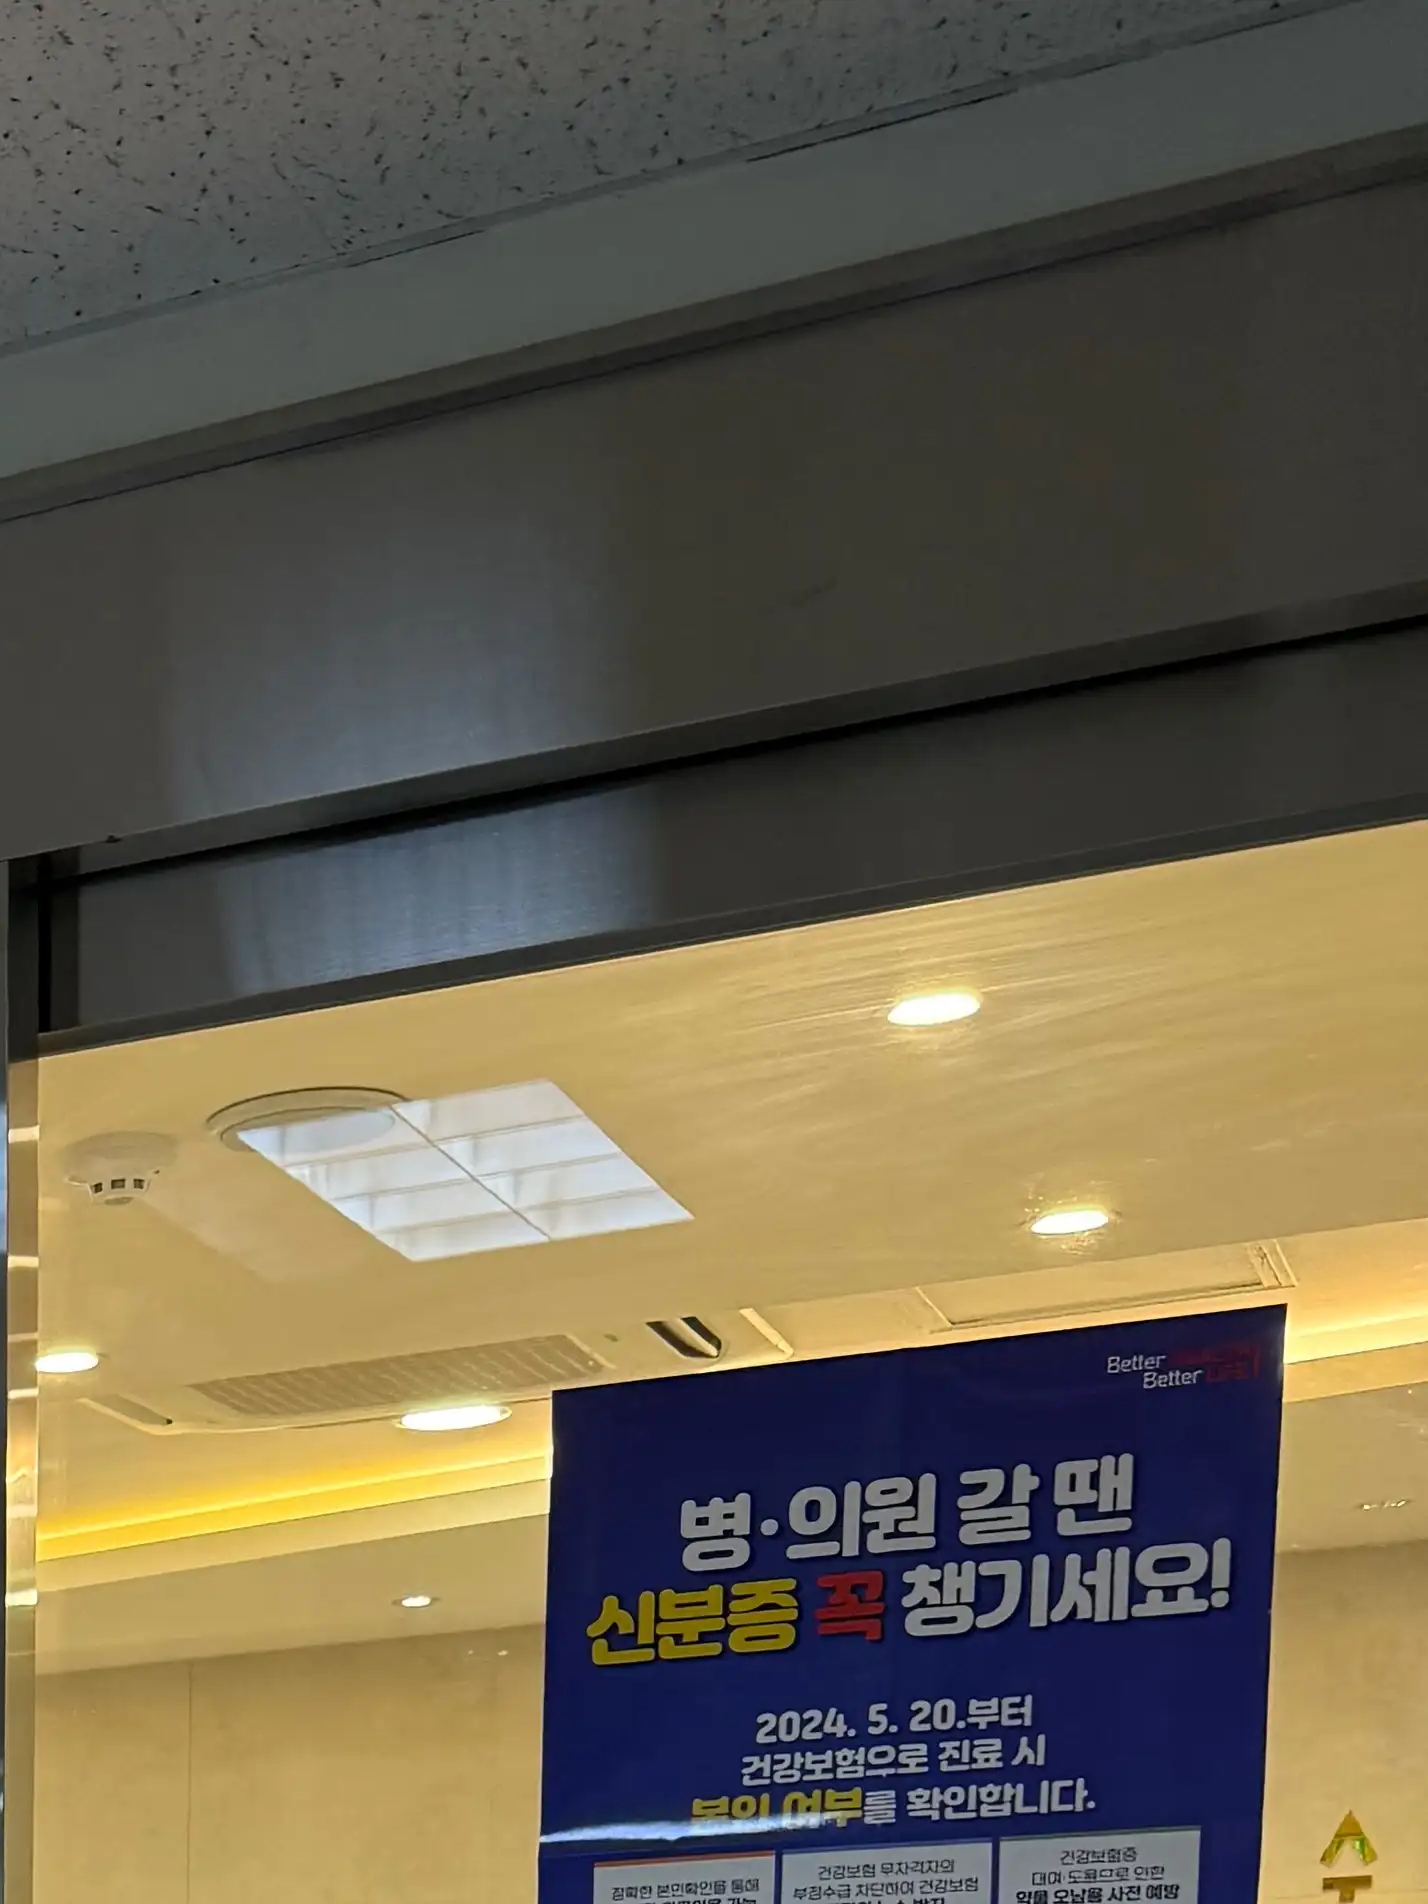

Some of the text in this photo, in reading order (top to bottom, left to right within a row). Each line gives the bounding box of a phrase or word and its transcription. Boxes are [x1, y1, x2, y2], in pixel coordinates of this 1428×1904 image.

[1107, 1354, 1166, 1374] Better
[1143, 1370, 1204, 1389] Better
[680, 1453, 1134, 1572] 병·의원 갈 땐
[586, 1537, 1231, 1666] 신분증 꼭 챙기세요!
[755, 1694, 1033, 1744] 2024. 5. 20.부터
[740, 1734, 1046, 1787] 건강보험으로 진료 시
[783, 1778, 1097, 1828] 여부를 확인합니다.
[1107, 1885, 1141, 1901] 사전
